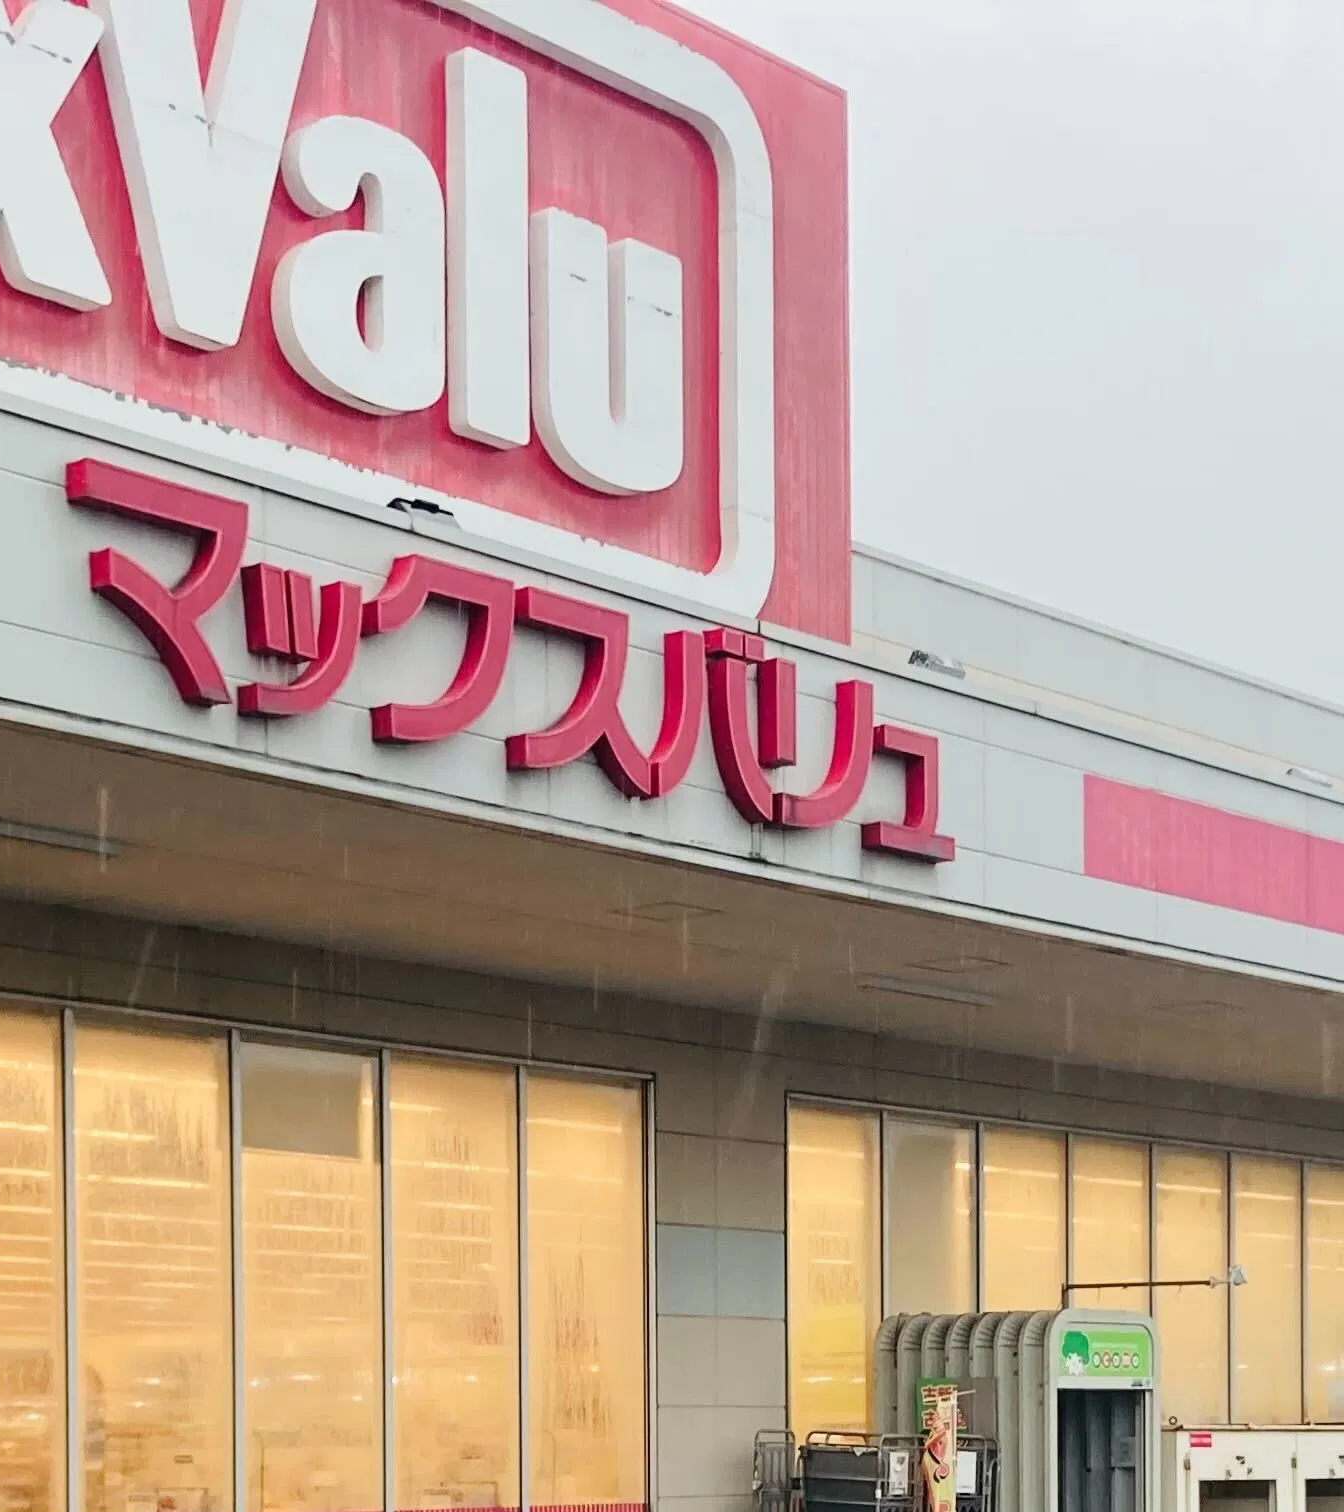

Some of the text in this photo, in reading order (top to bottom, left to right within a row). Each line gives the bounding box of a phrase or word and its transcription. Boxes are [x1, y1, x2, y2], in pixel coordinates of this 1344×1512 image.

[65, 457, 956, 864] マックスバリュ
